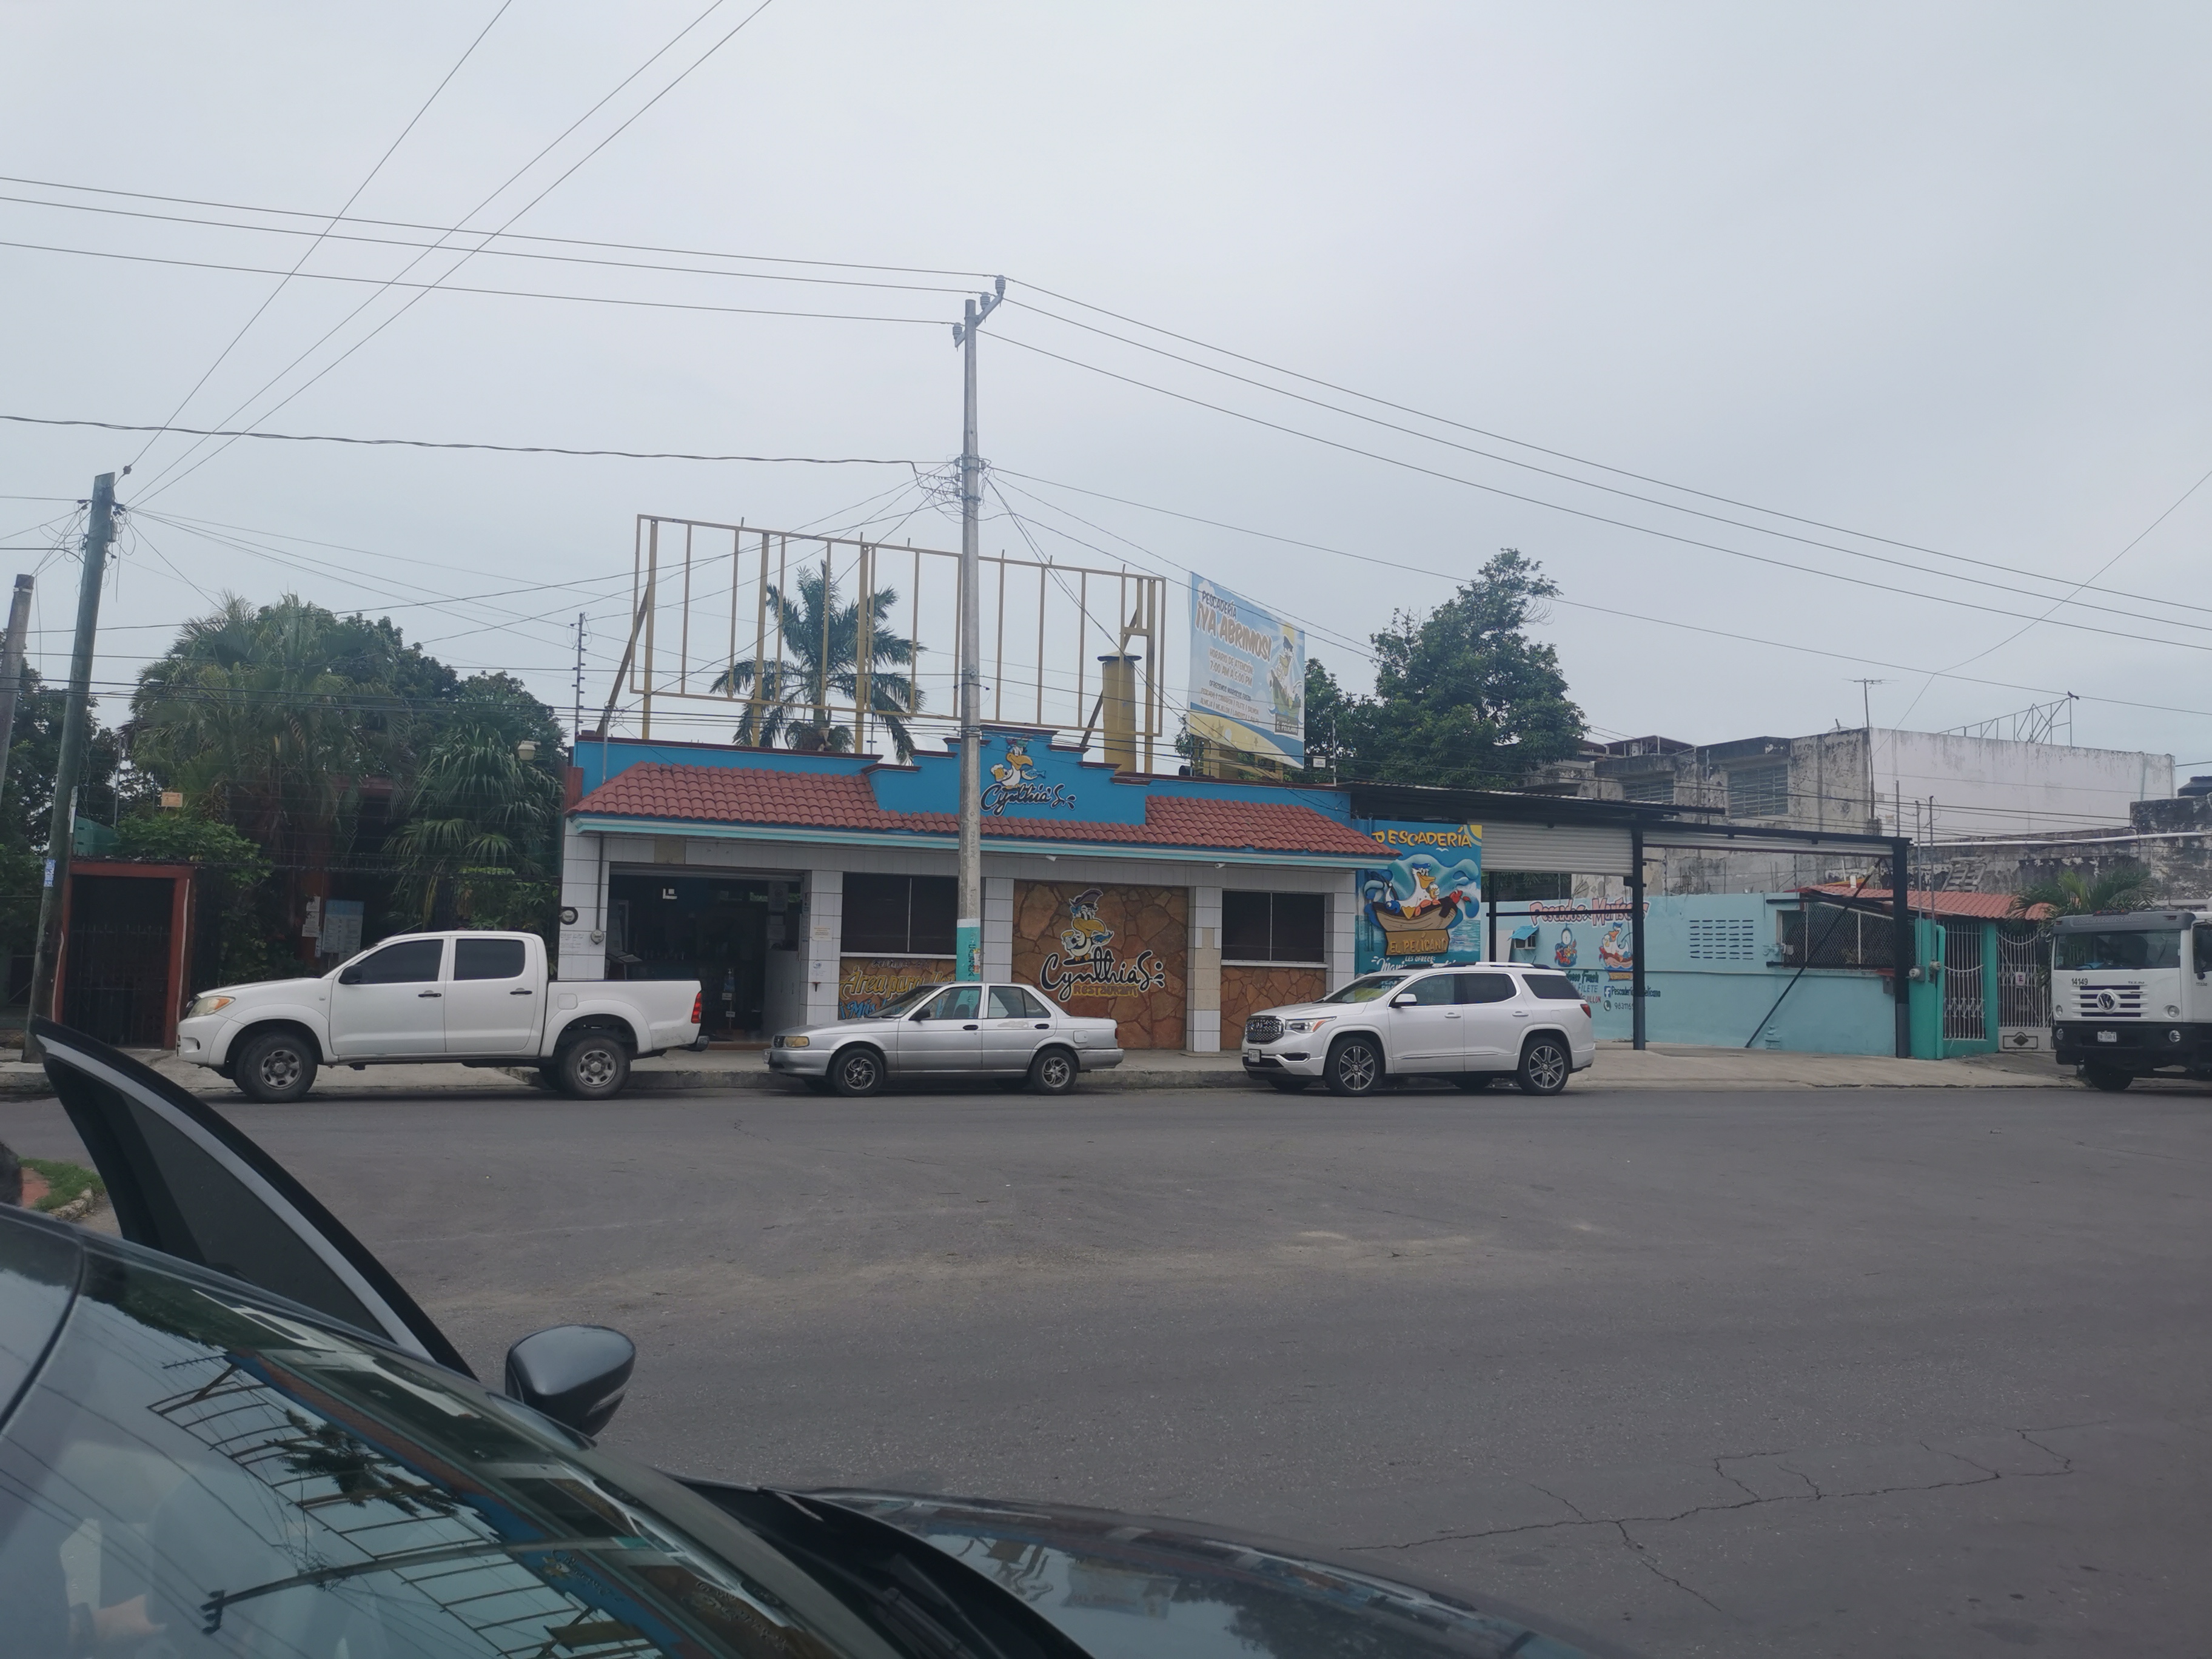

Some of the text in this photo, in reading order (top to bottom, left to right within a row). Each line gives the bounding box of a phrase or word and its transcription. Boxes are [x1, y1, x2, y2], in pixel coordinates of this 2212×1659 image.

[1202, 591, 1237, 619] PESCADERÍA
[1195, 600, 1272, 662] ¡YA ABRIMOS!
[1210, 660, 1221, 674] 7:00
[1222, 665, 1230, 678] AM
[1230, 668, 1233, 680] A
[1245, 675, 1253, 688] PM
[1228, 656, 1234, 667] DE
[1372, 826, 1472, 848] PESCADERÍA
[1389, 941, 1401, 954] EL
[839, 965, 888, 1000] Área
[1577, 983, 1598, 993] FILETE
